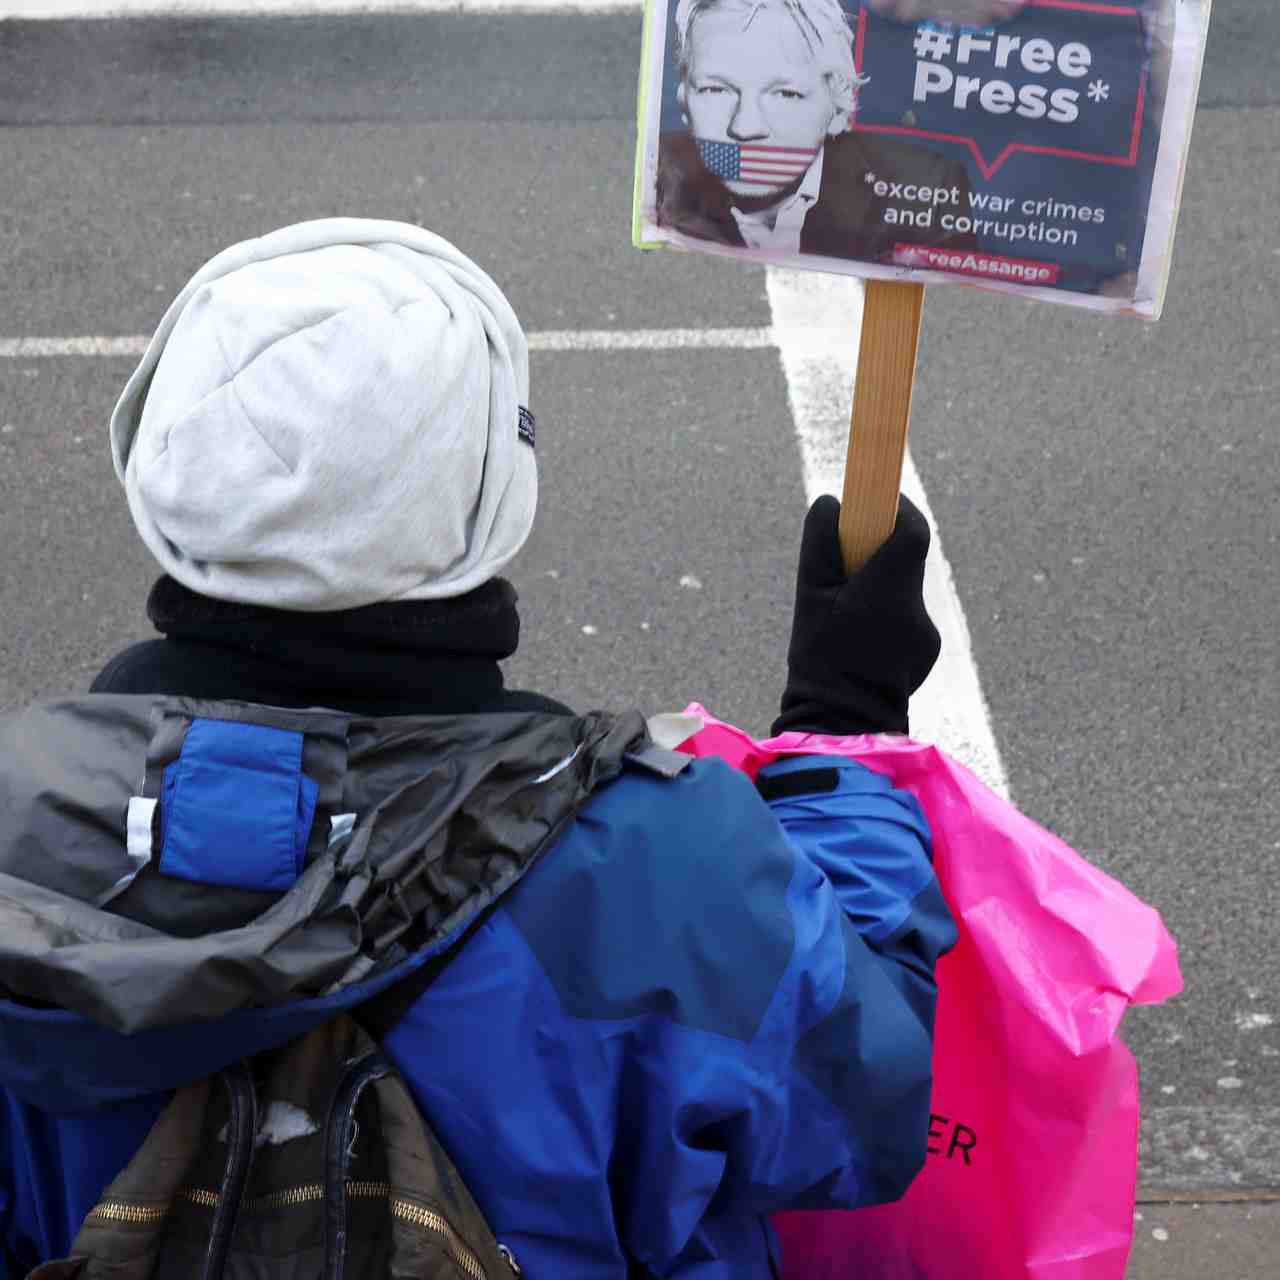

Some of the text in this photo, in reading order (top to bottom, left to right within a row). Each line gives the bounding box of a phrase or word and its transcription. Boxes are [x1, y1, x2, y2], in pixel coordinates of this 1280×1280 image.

[913, 21, 1092, 78] #Free
[883, 206, 1078, 246] and corruption
[968, 191, 1015, 214] war
[1021, 197, 1105, 224] crimes
